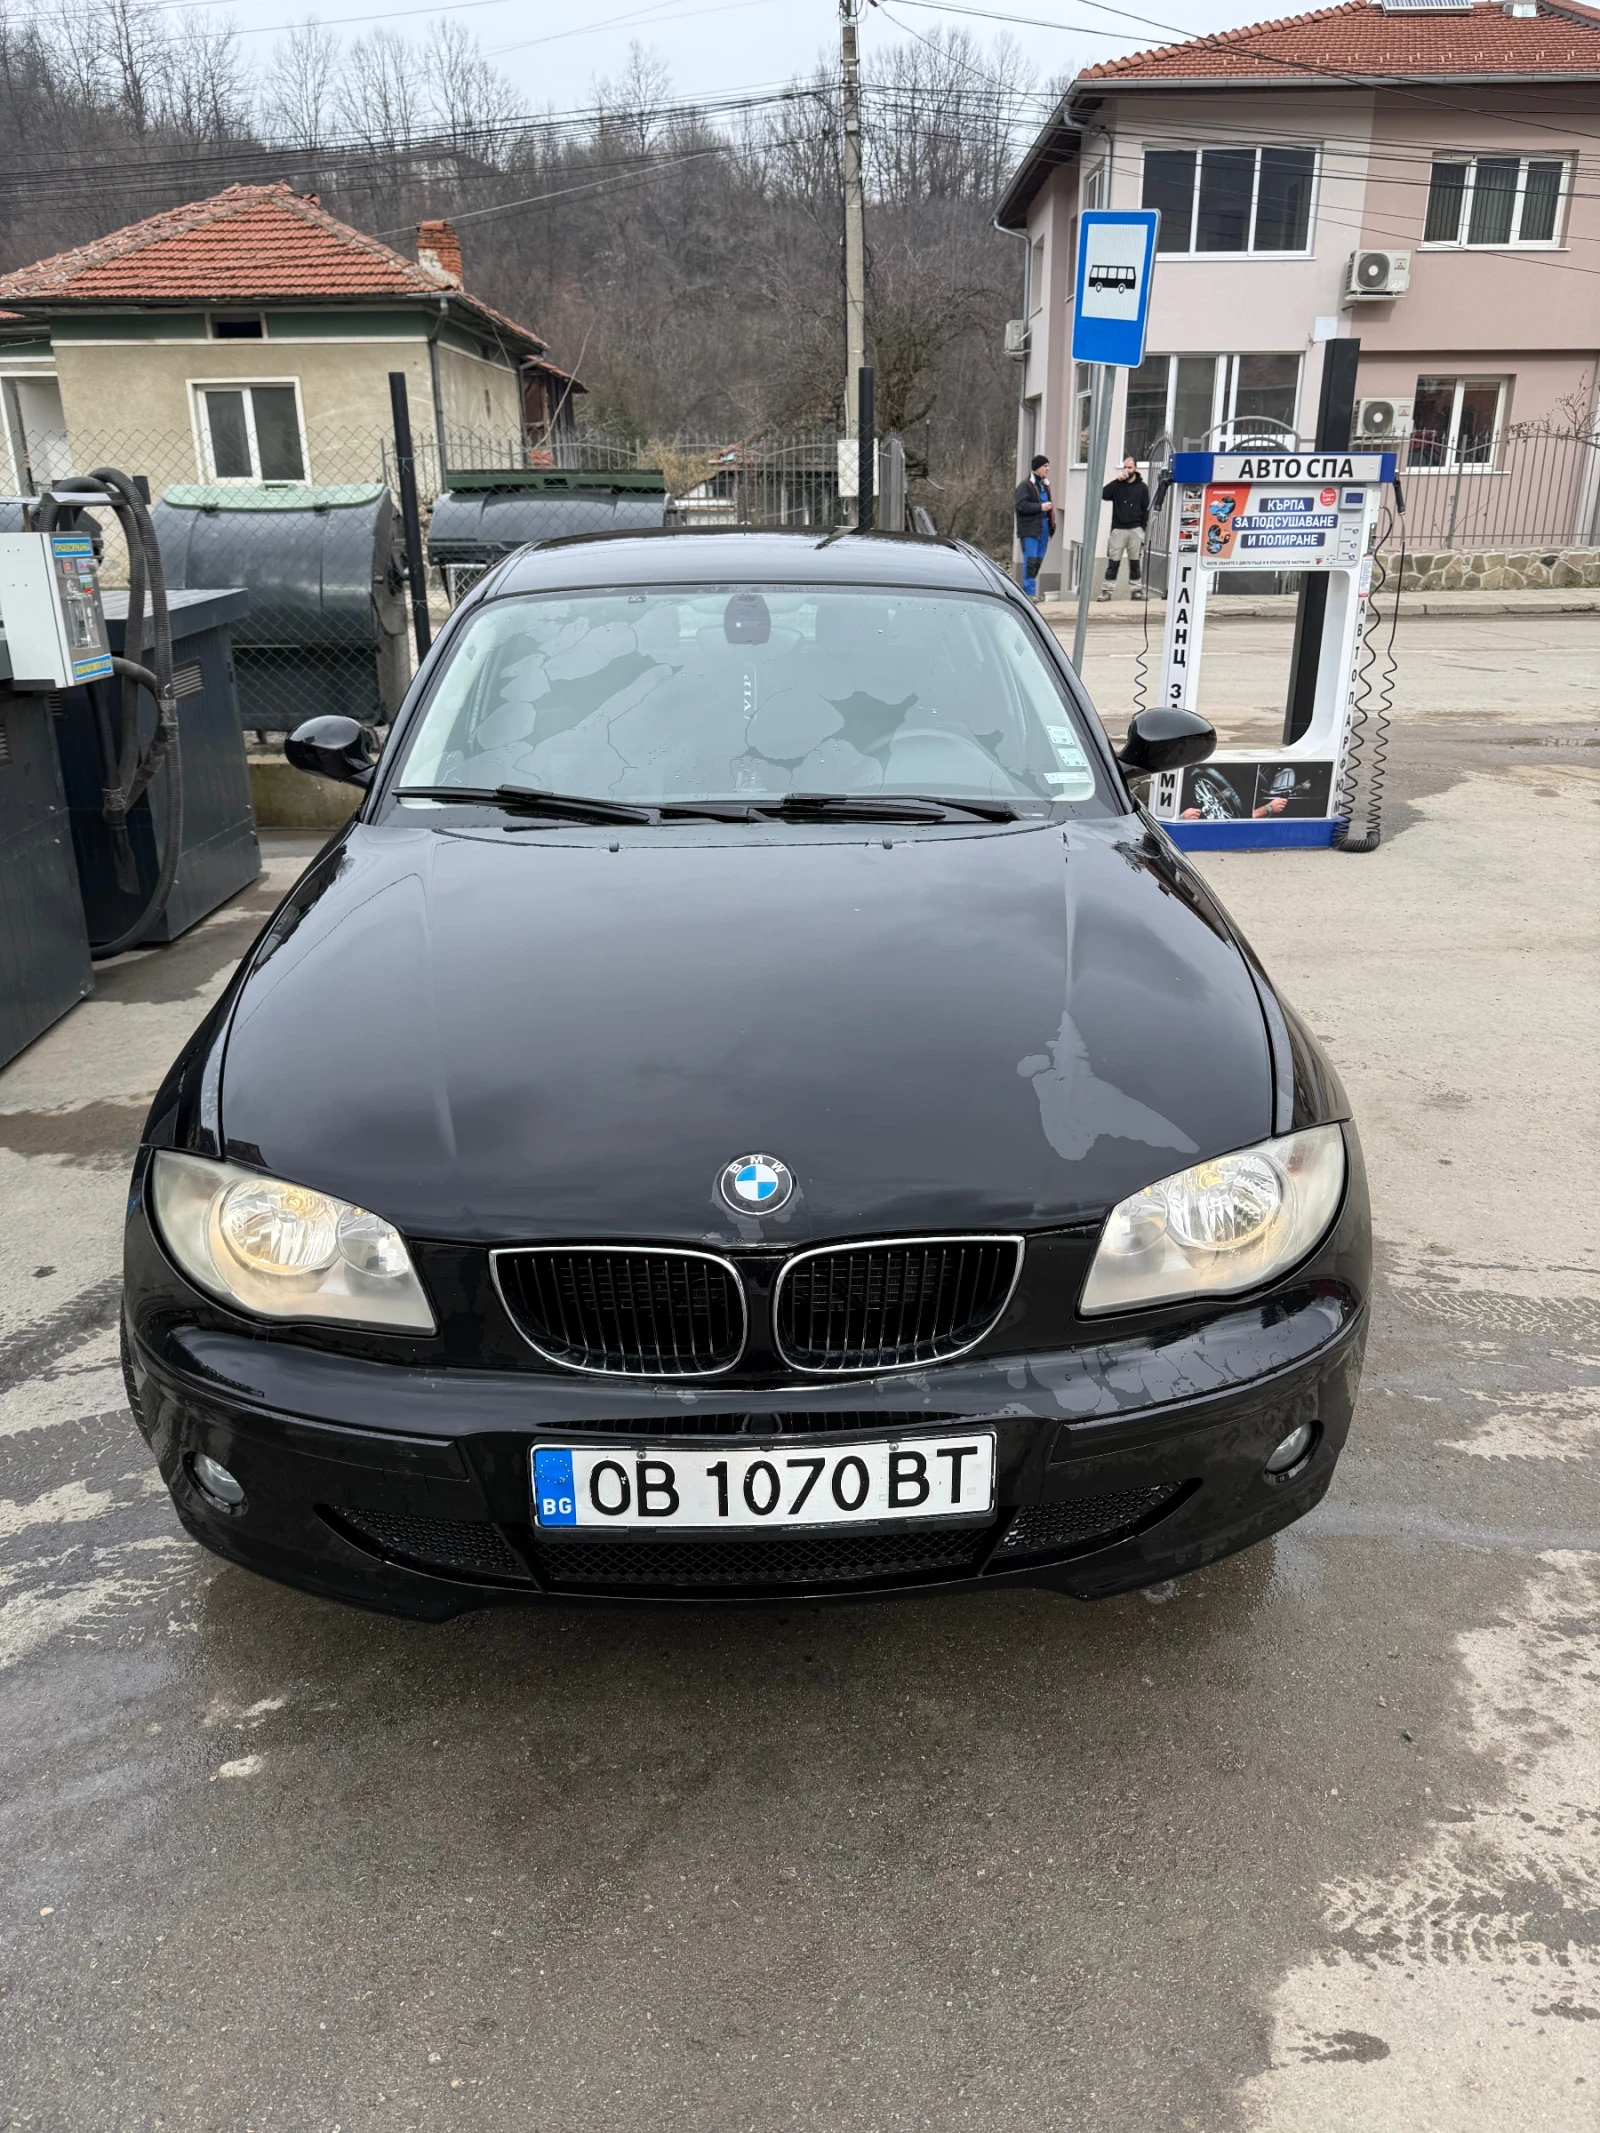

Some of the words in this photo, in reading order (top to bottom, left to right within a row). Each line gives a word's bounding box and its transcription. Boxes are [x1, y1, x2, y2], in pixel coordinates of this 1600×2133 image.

[1238, 458, 1301, 479] АВТО
[1306, 458, 1354, 478] СПА
[1267, 499, 1305, 511] КЪРПА
[1234, 516, 1249, 528] ЗА
[1252, 514, 1335, 529] ПОДСУШАВАНЕ
[1247, 535, 1257, 546] И
[1258, 533, 1318, 546] ПОЛИРАНЕ
[1173, 567, 1192, 668] ГЛАНЦ
[728, 1156, 785, 1174] BMW
[589, 1460, 680, 1517] OB
[706, 1456, 870, 1518] 1070
[888, 1446, 978, 1509] BT
[542, 1498, 572, 1516] BG
